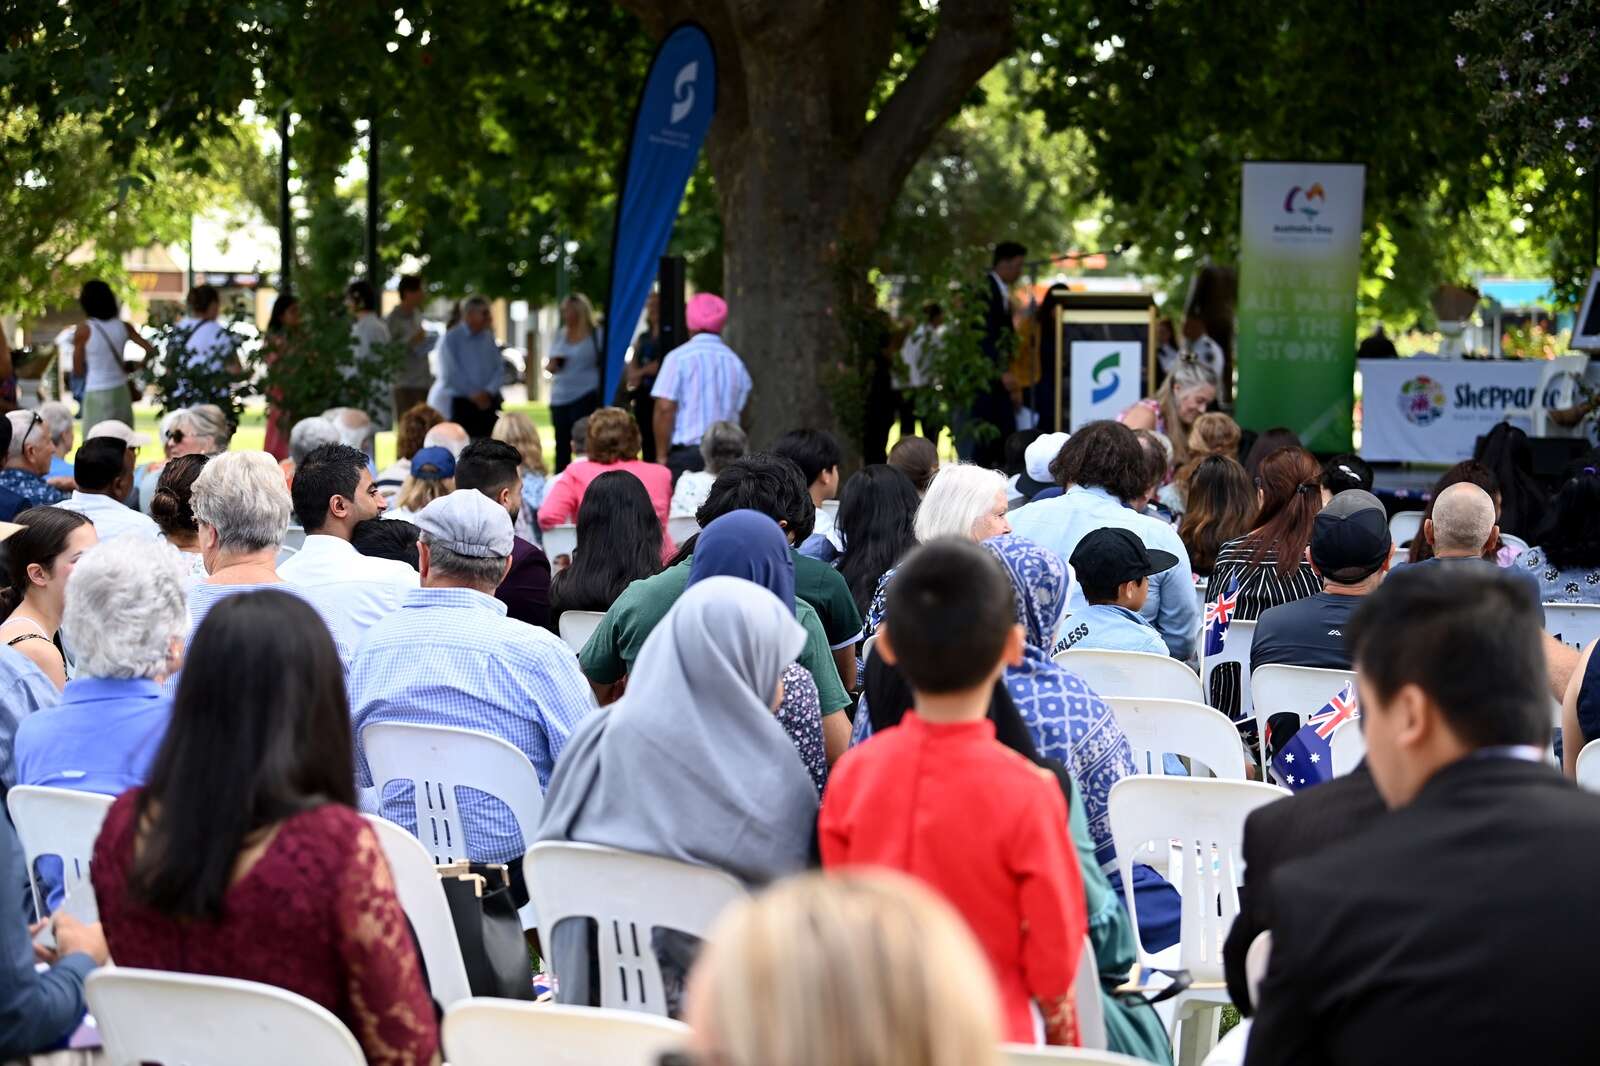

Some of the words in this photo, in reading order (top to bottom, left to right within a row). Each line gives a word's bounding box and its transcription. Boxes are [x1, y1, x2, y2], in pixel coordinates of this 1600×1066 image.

[1243, 292, 1286, 312] ALL
[1295, 293, 1354, 313] PART
[1256, 316, 1289, 336] OF
[1297, 316, 1340, 338] THE
[1256, 341, 1339, 363] STORY.
[1454, 382, 1577, 411] Sheppar
[1050, 622, 1089, 658] ARLESS
